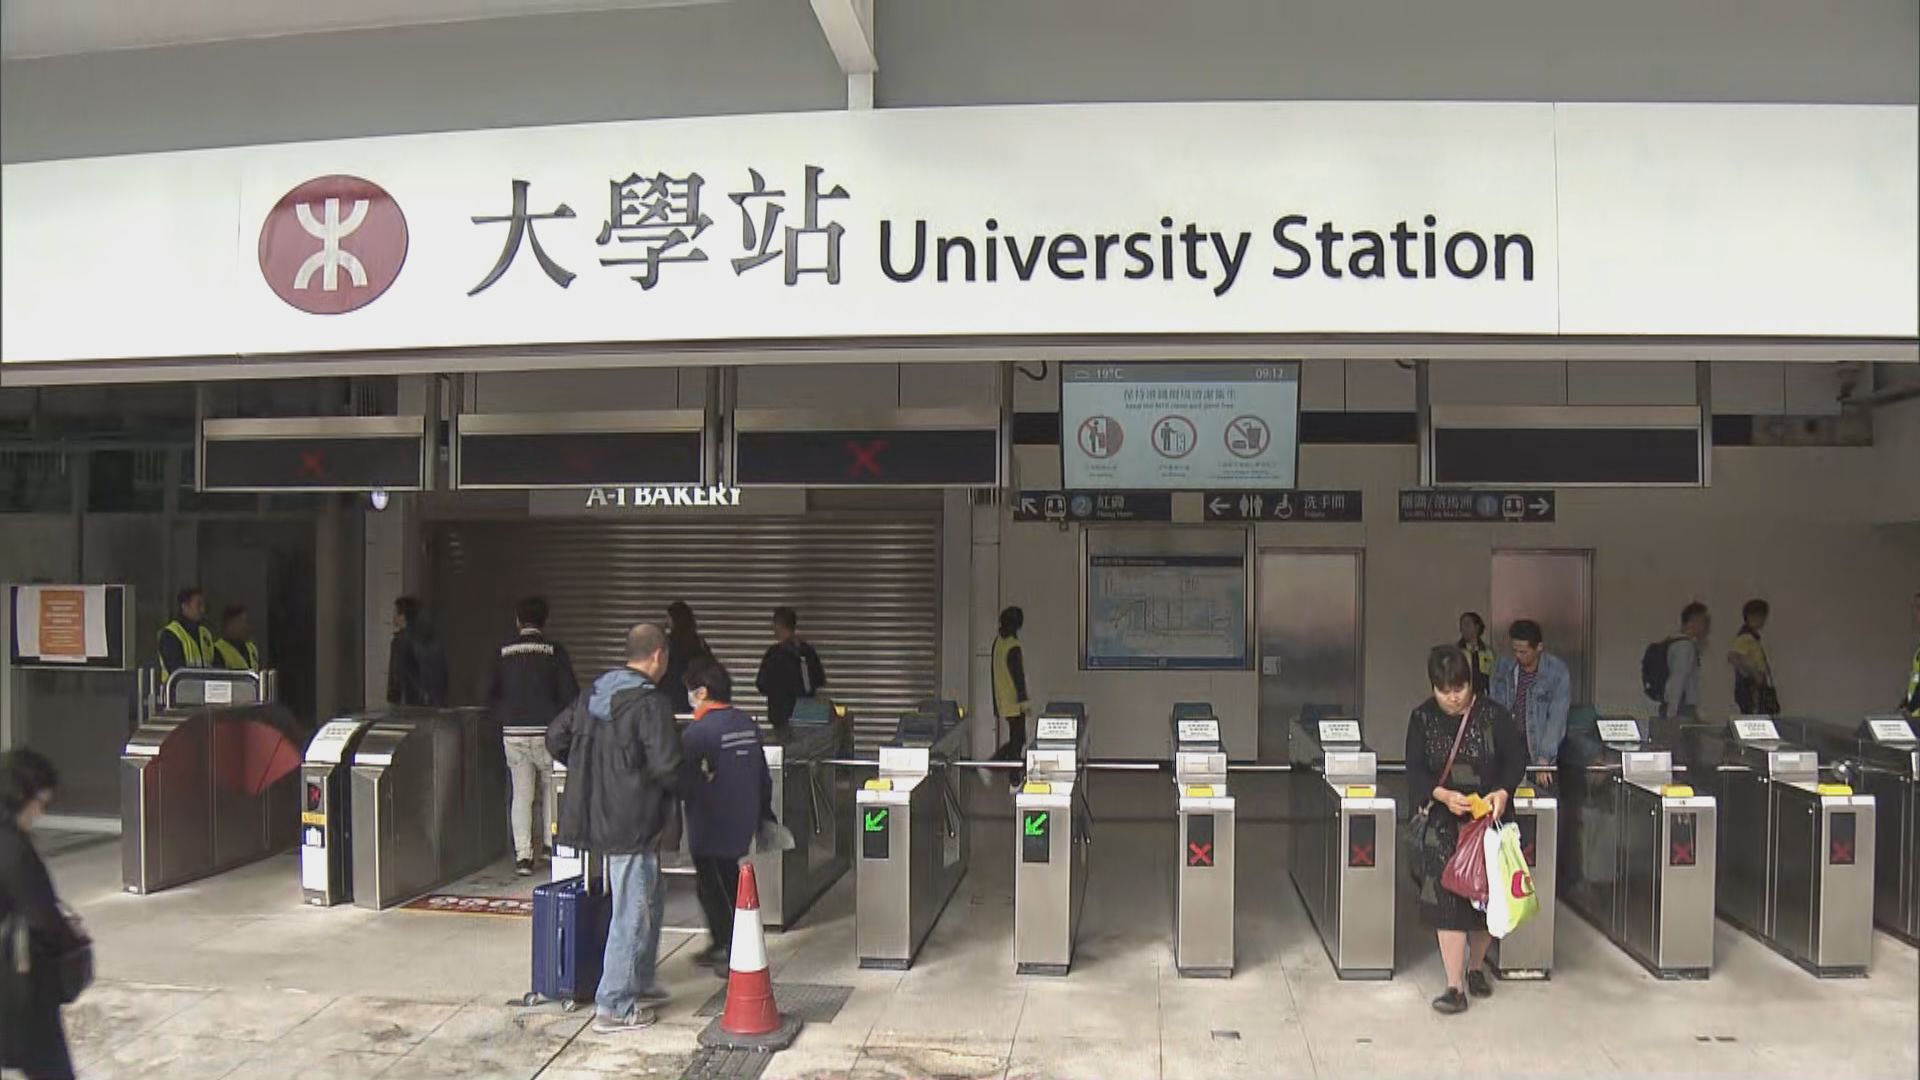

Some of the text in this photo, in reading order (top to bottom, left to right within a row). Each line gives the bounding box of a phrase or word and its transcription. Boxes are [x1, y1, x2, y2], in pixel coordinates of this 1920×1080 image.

[467, 164, 1534, 297] 大學站 University Station
[634, 484, 741, 506] BAKERY
